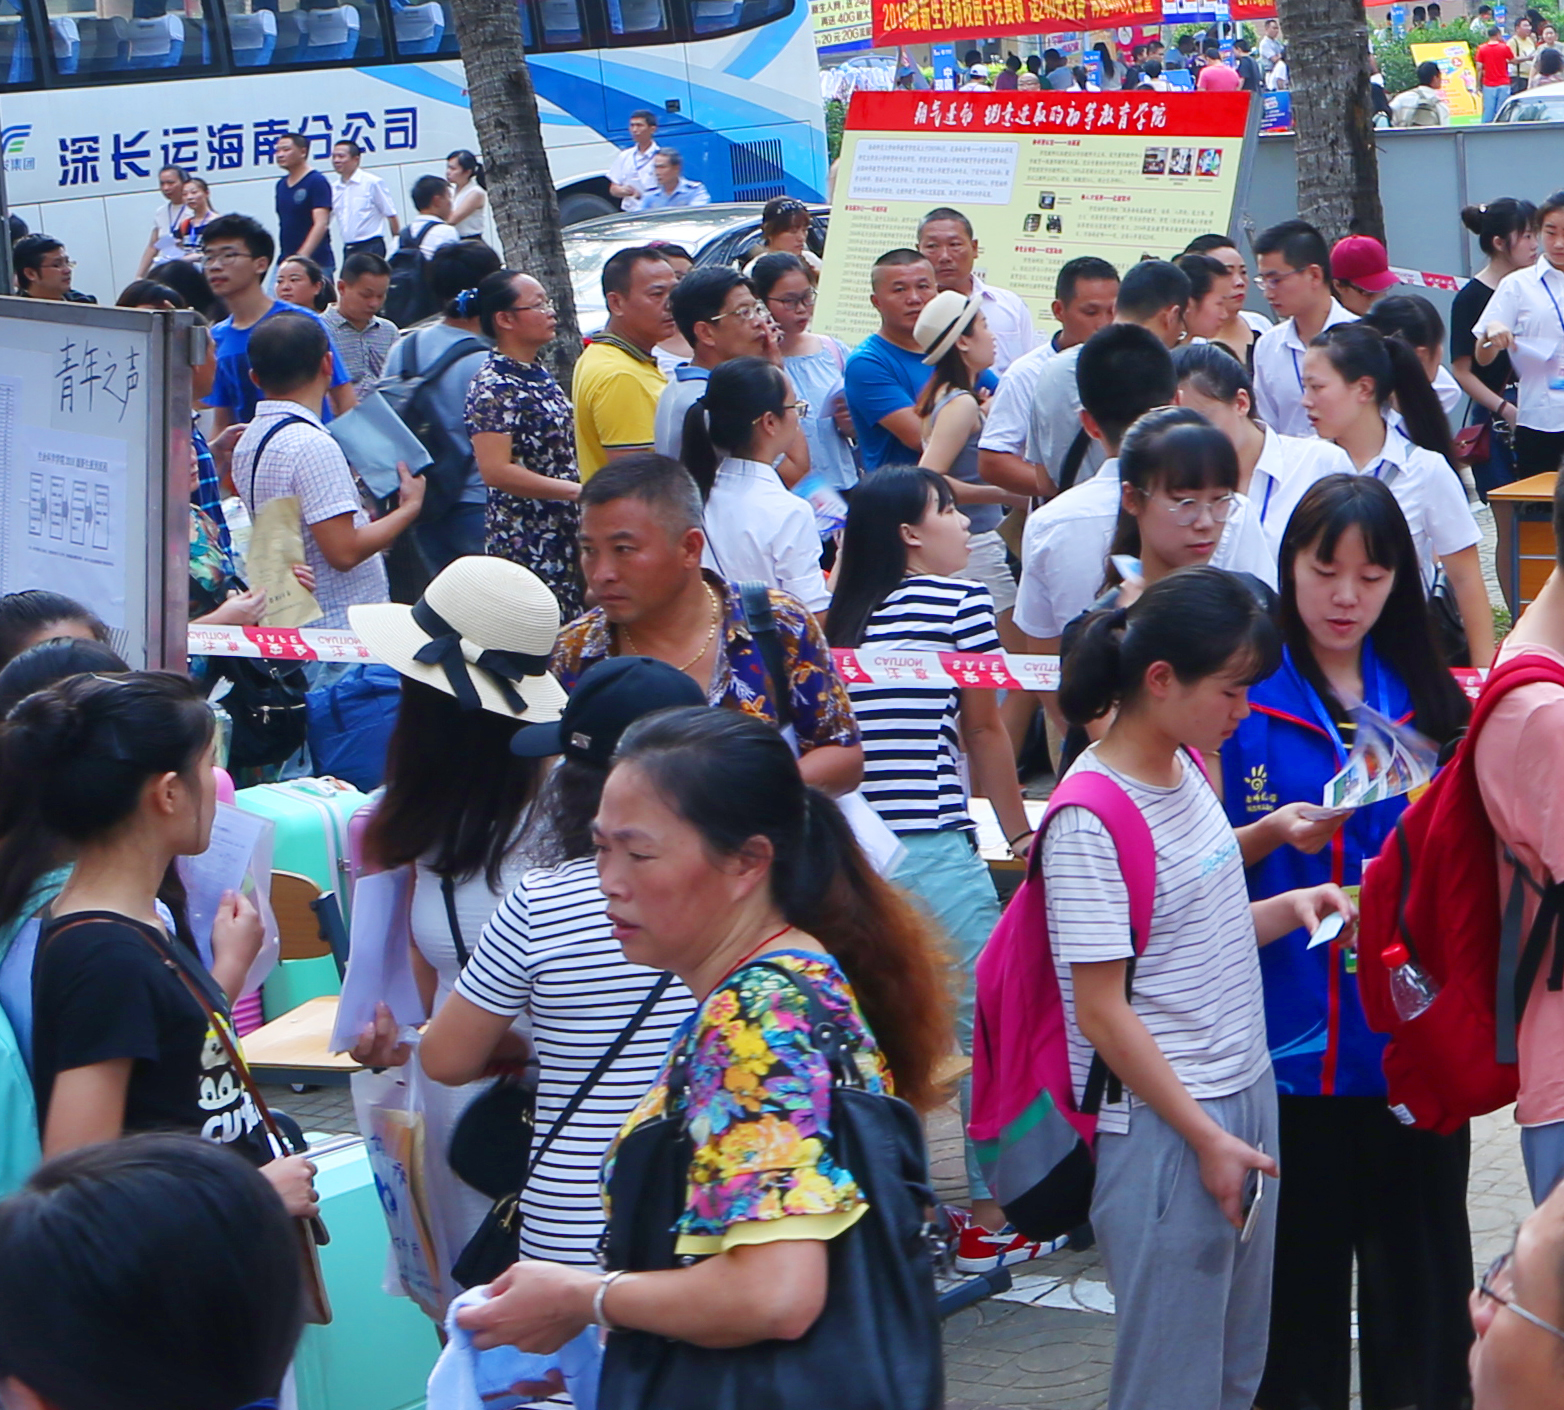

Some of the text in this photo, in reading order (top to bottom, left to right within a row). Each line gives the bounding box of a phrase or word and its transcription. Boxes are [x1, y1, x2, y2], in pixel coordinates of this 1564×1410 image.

[58, 106, 419, 187] 深长运海南分公司
[55, 336, 140, 423] 青年之声
